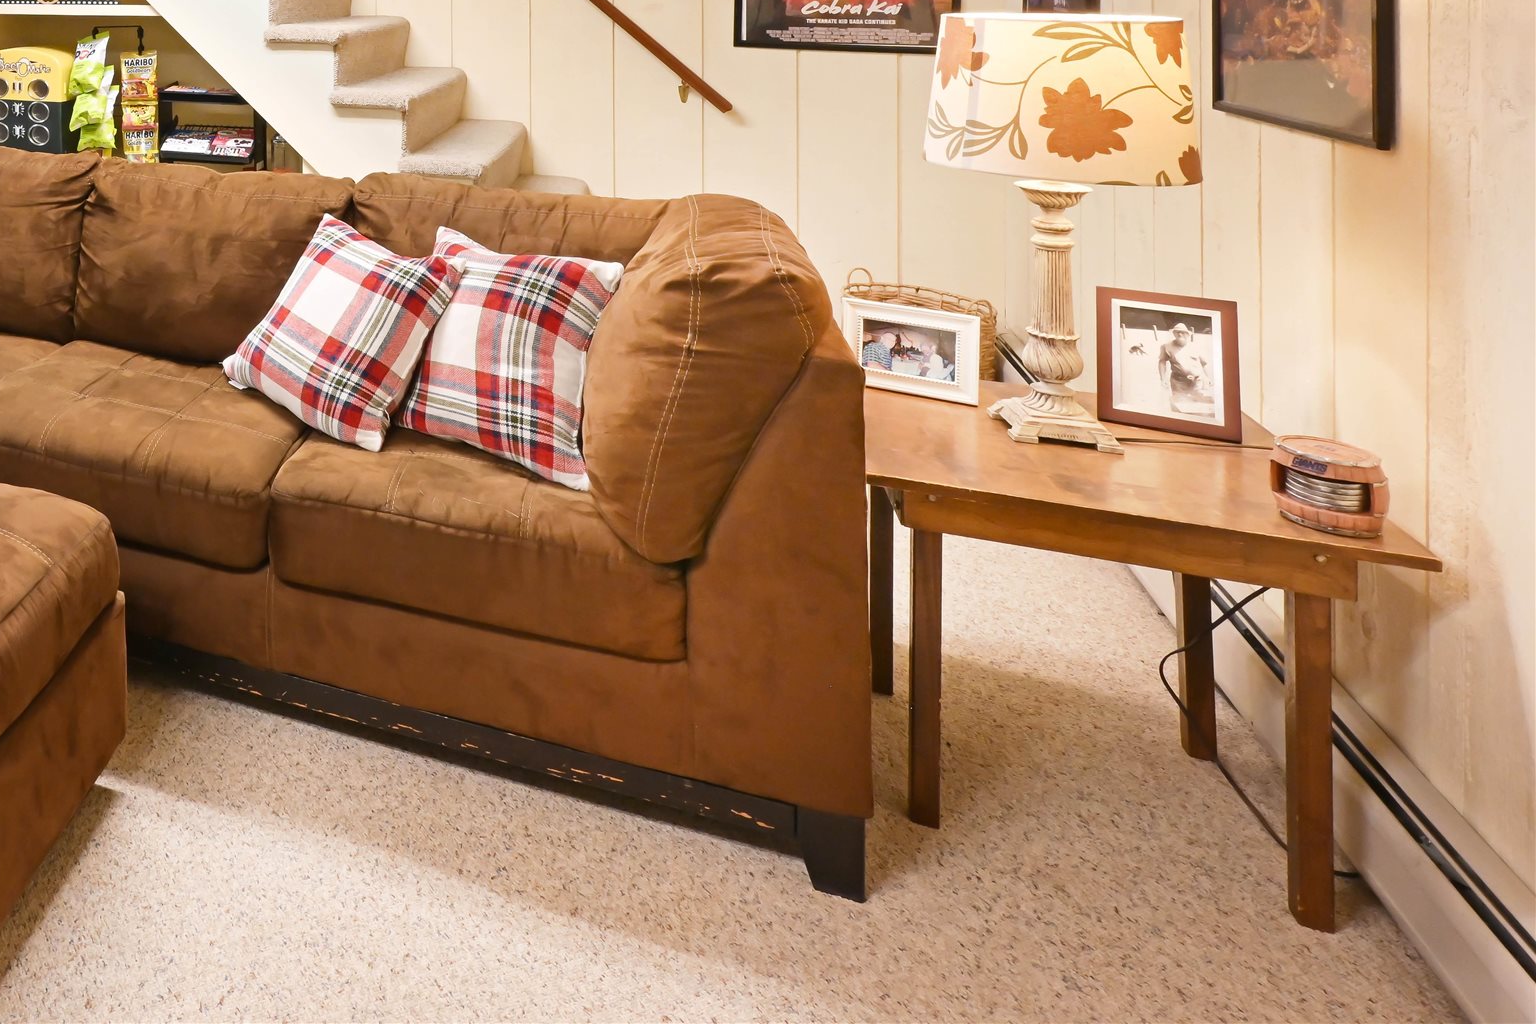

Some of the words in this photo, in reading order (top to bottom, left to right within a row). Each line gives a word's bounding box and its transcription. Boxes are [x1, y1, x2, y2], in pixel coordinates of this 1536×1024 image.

[866, 0, 903, 16] Kai
[124, 58, 153, 67] HARIBO
[125, 130, 154, 139] HARIBO
